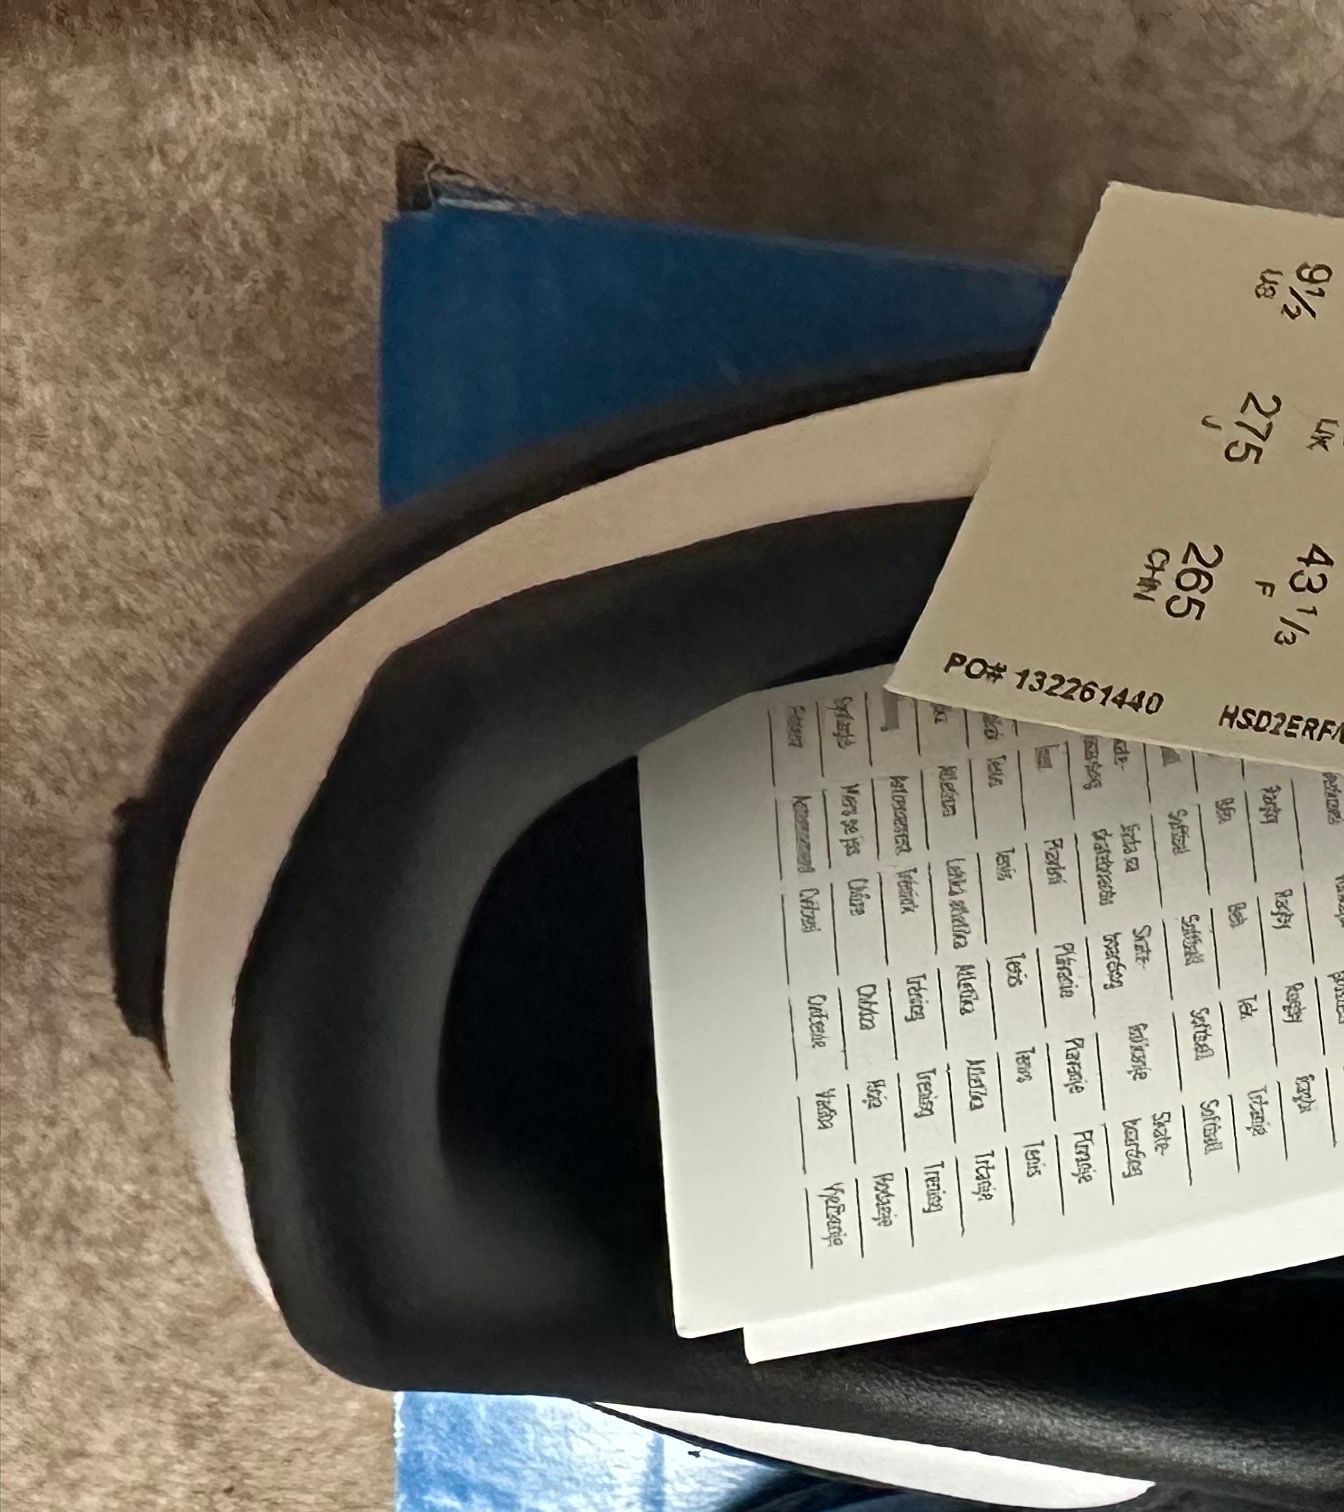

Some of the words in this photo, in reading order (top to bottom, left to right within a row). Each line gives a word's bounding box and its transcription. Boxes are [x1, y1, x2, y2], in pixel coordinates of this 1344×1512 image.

[1225, 392, 1282, 464] 275
[1307, 419, 1339, 451] UK
[1133, 548, 1171, 603] CHN
[1164, 542, 1223, 620] 265
[944, 652, 1007, 683] PO#
[1015, 669, 1164, 714] 132261440
[1024, 1140, 1045, 1177] Tenis
